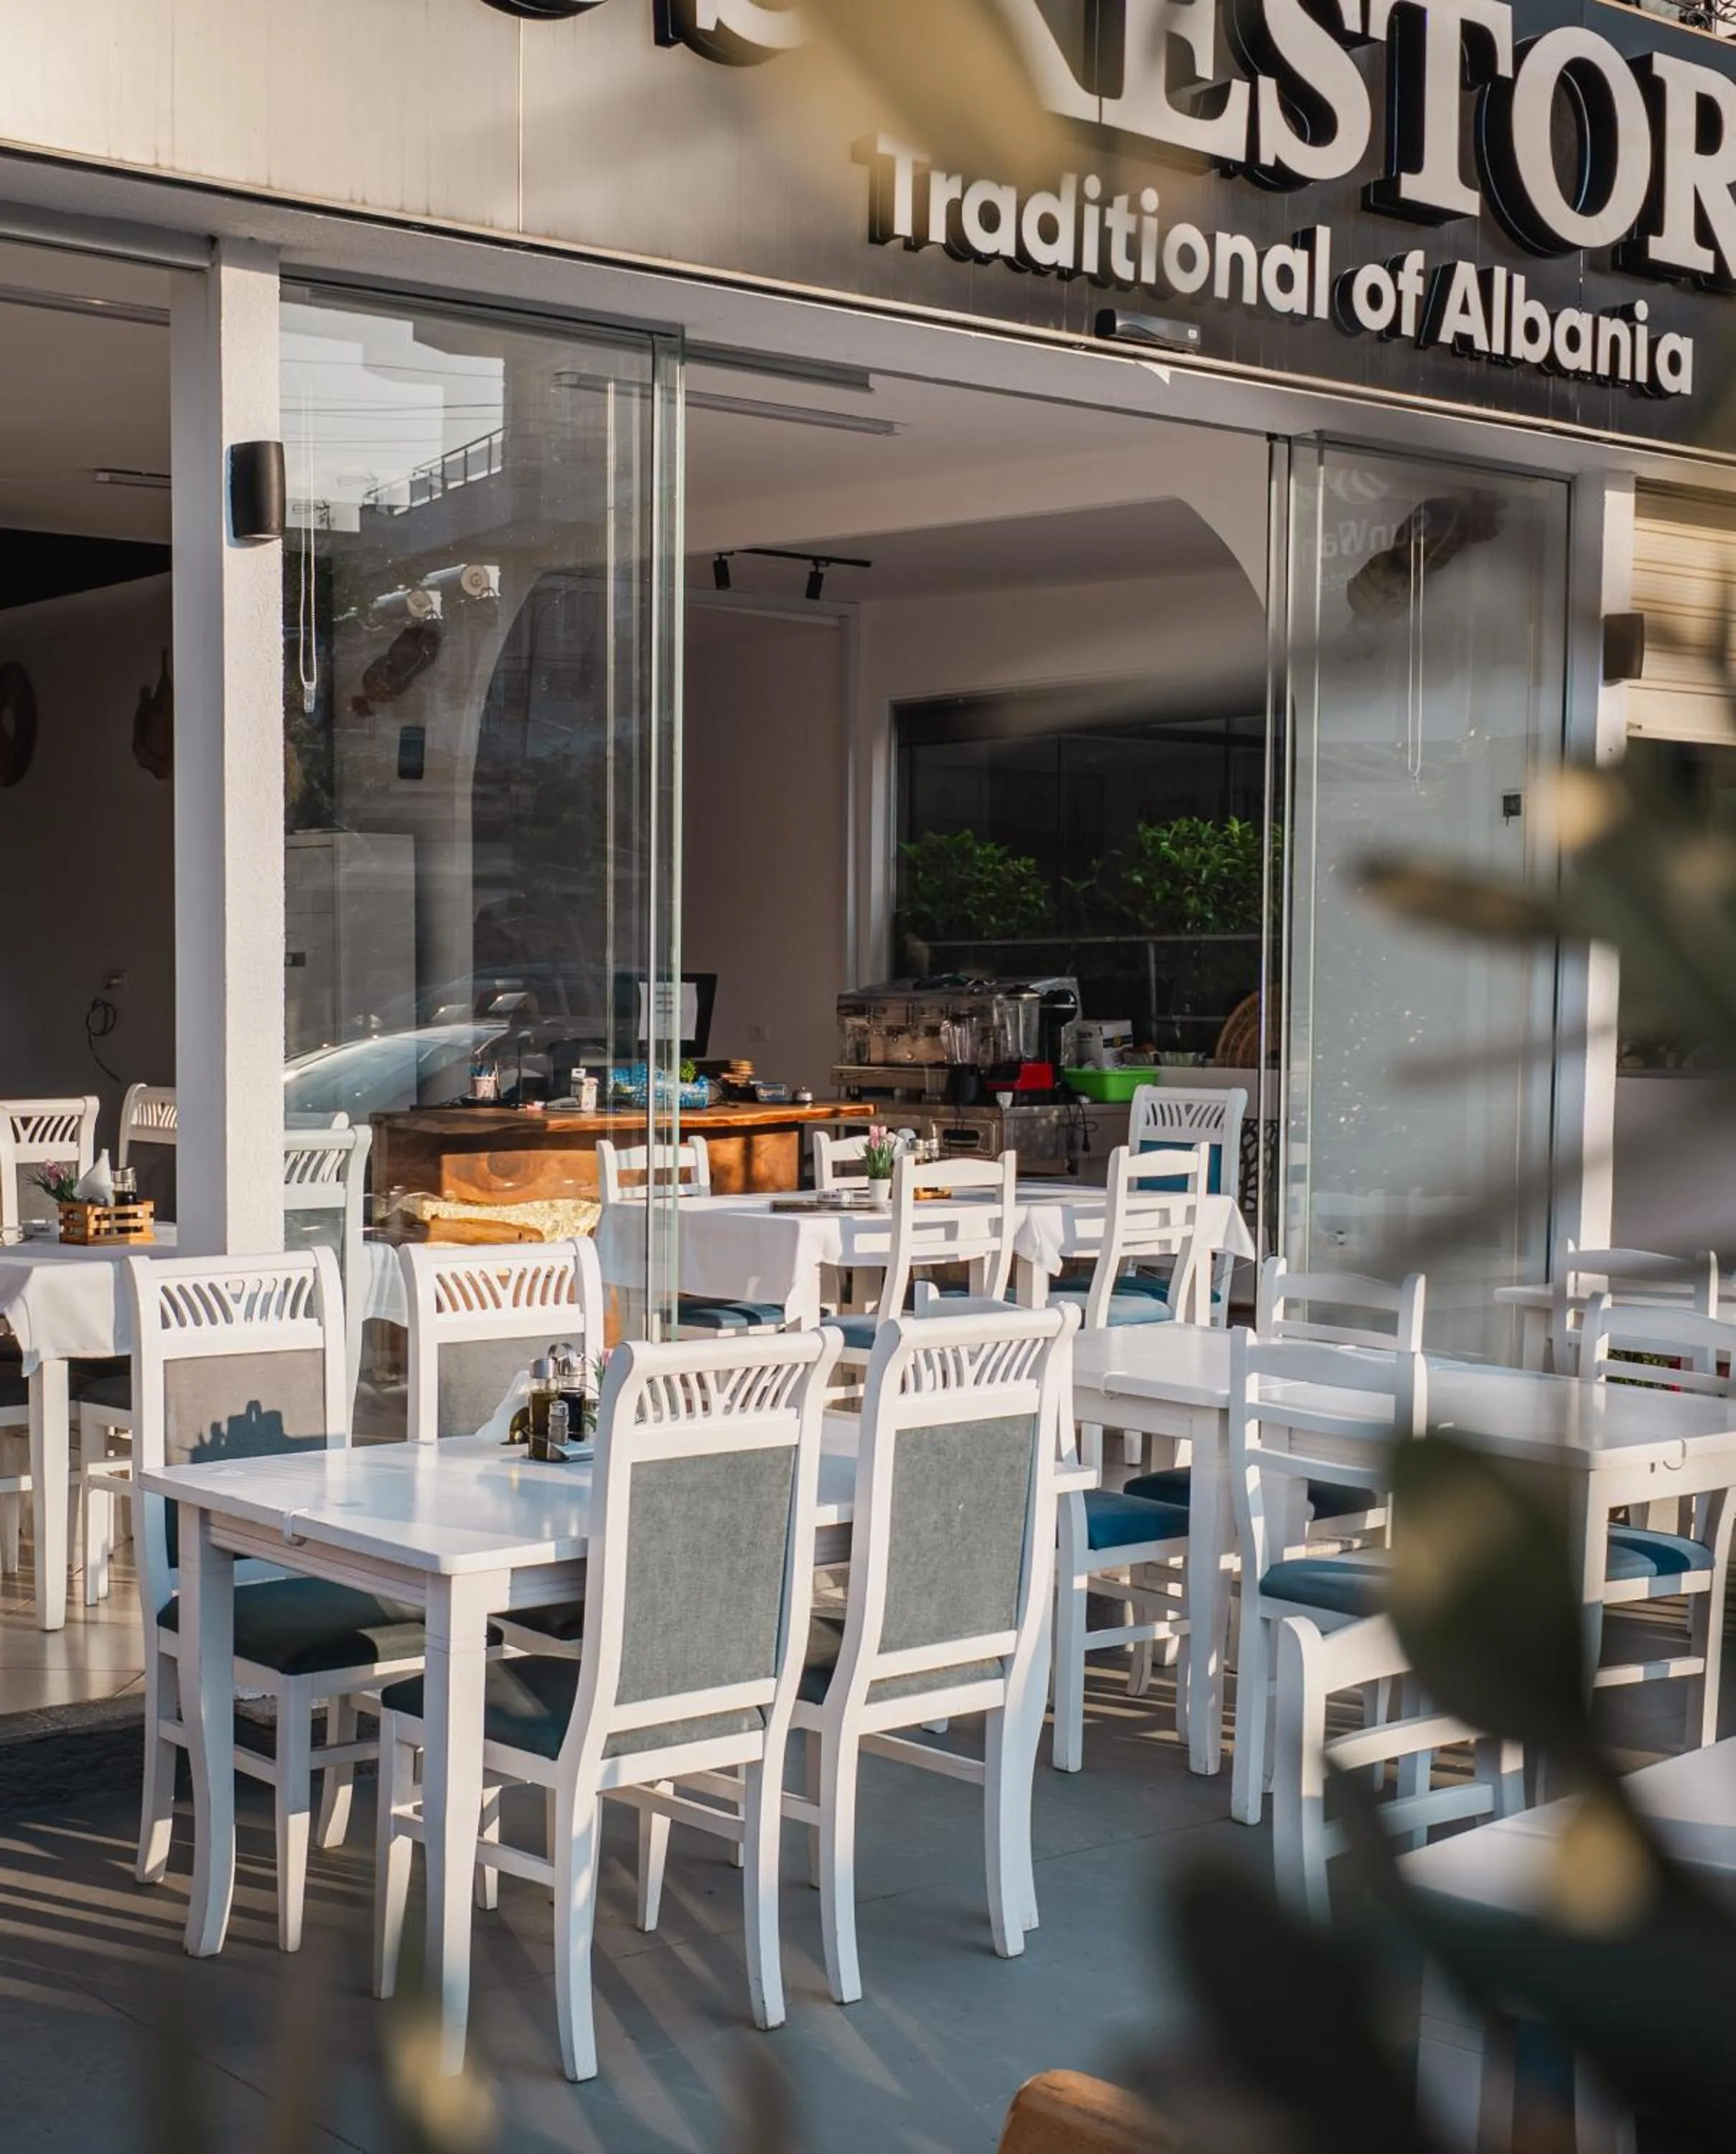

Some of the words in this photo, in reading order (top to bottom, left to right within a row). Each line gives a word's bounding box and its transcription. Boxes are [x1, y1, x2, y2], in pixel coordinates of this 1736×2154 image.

[877, 134, 1331, 319] Traditional
[1352, 250, 1425, 337] of
[1438, 260, 1693, 396] Albania
